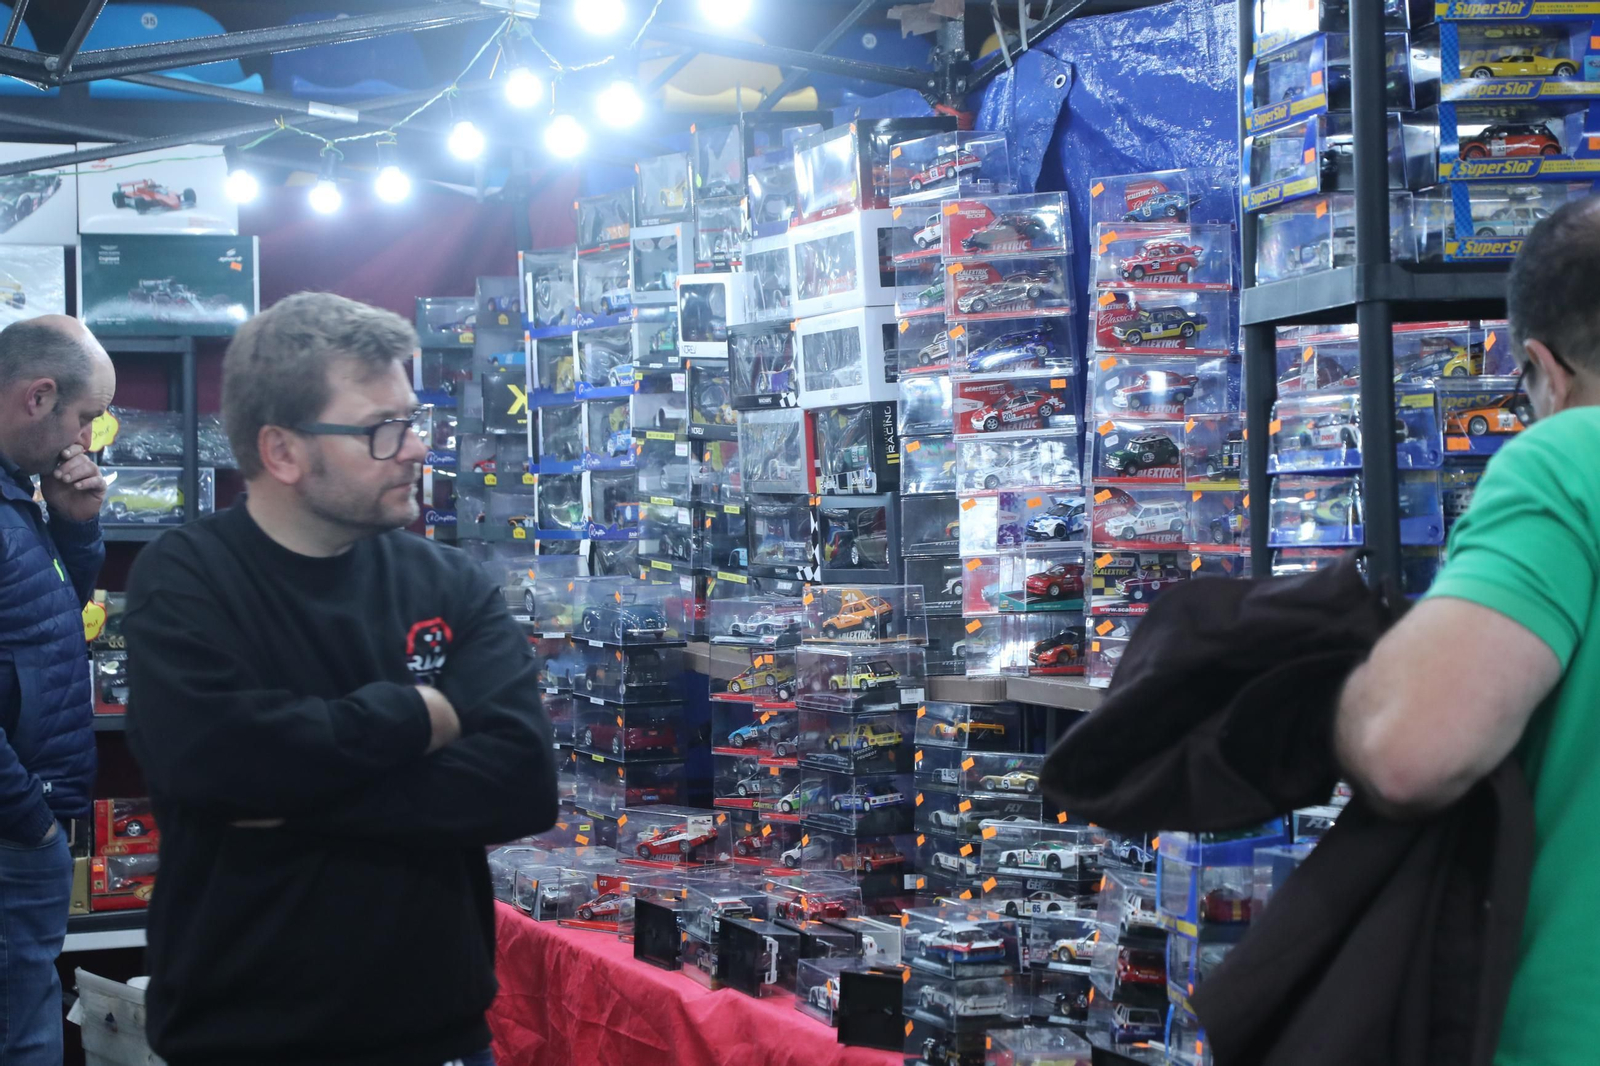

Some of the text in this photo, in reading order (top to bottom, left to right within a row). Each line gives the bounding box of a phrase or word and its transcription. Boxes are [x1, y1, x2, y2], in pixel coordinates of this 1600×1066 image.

[1453, 1, 1526, 15] SuperSlot
[1457, 160, 1535, 176] SuperSlot
[1098, 313, 1134, 327] Classics
[885, 405, 896, 453] RACING
[1002, 778, 1010, 789] 5
[1004, 803, 1023, 813] FLY
[600, 879, 608, 887] GT
[1032, 904, 1041, 913] 65
